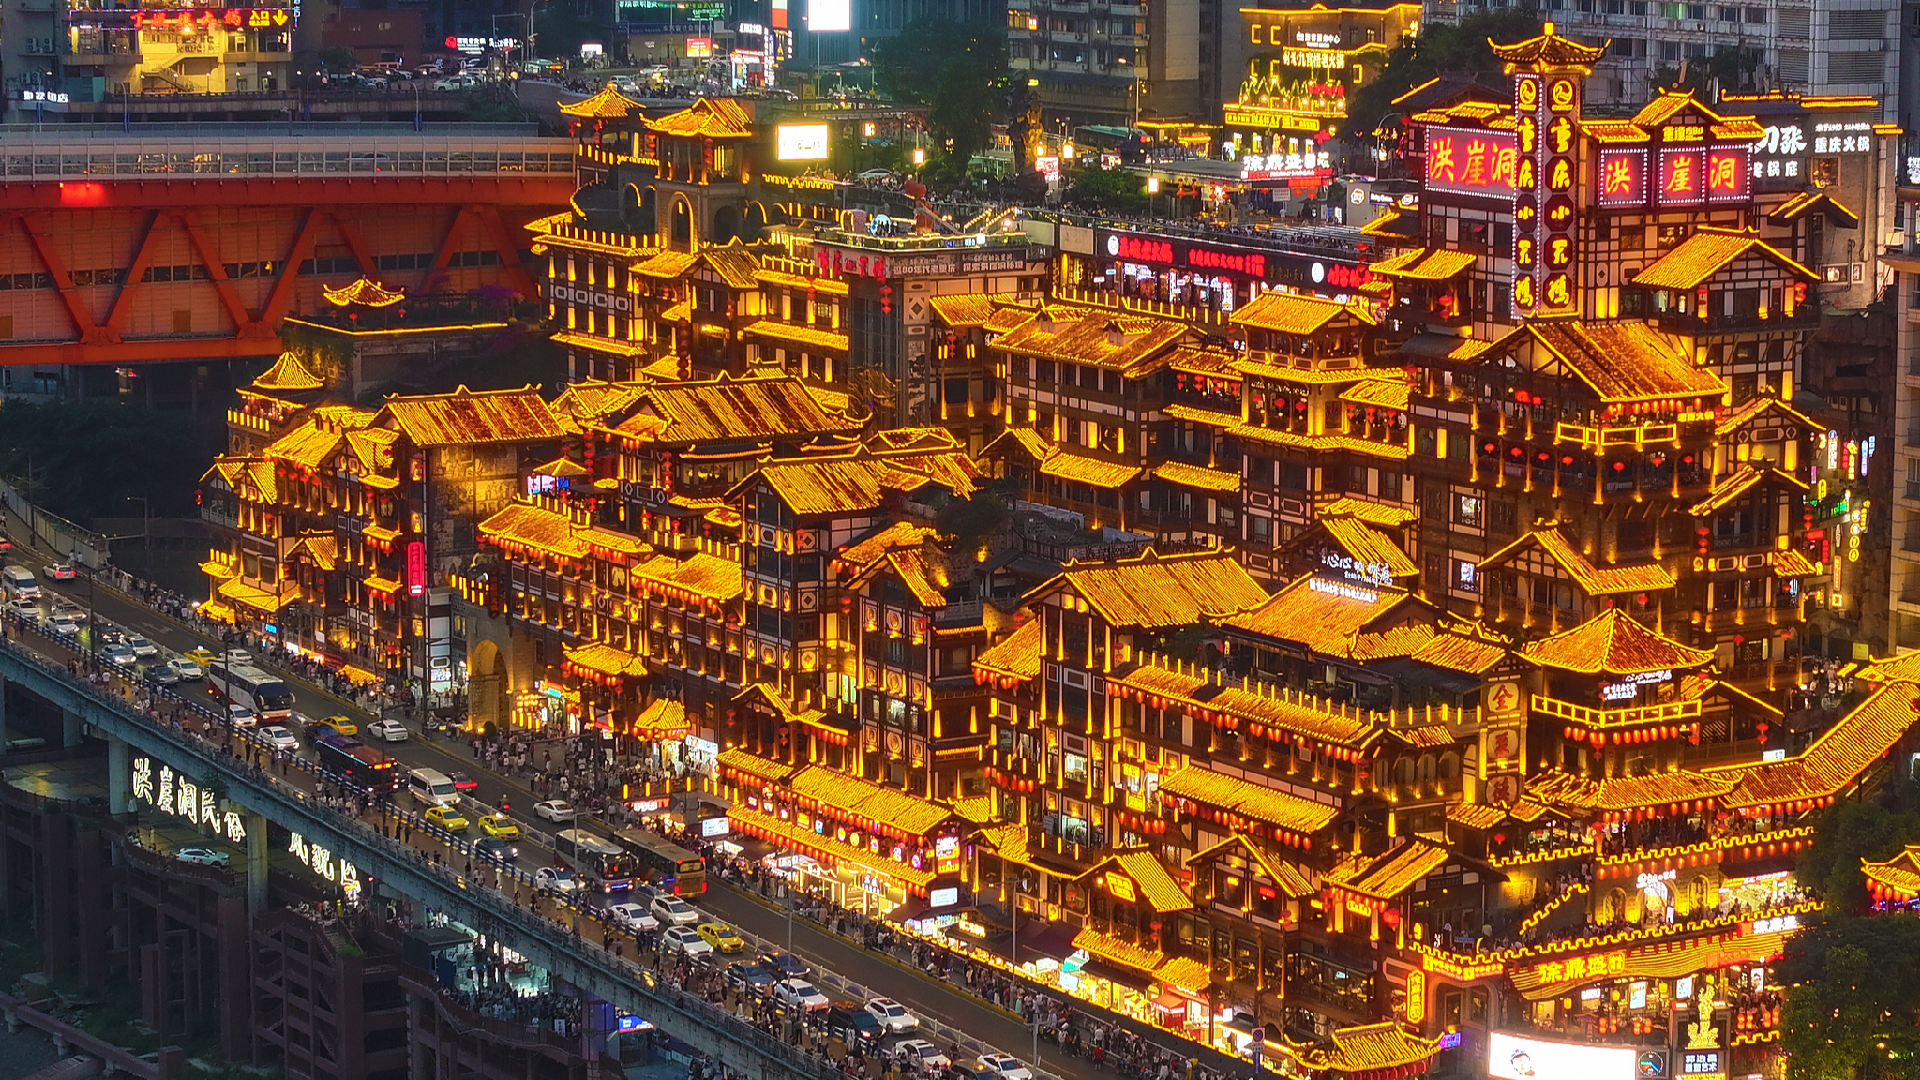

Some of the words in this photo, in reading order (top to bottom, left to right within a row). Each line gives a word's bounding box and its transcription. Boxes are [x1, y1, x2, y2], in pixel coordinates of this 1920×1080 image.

[250, 10, 270, 20] 入口
[1429, 138, 1515, 188] 洪崖洞
[1815, 137, 1870, 154] 重庆火锅
[1606, 156, 1736, 193] 洪崖洞
[1515, 116, 1536, 308] 重庆小天鹅
[1548, 116, 1571, 308] 重庆小天鹅
[133, 757, 246, 842] 洪崖洞民俗
[1538, 955, 1608, 983] 徐鼎盛
